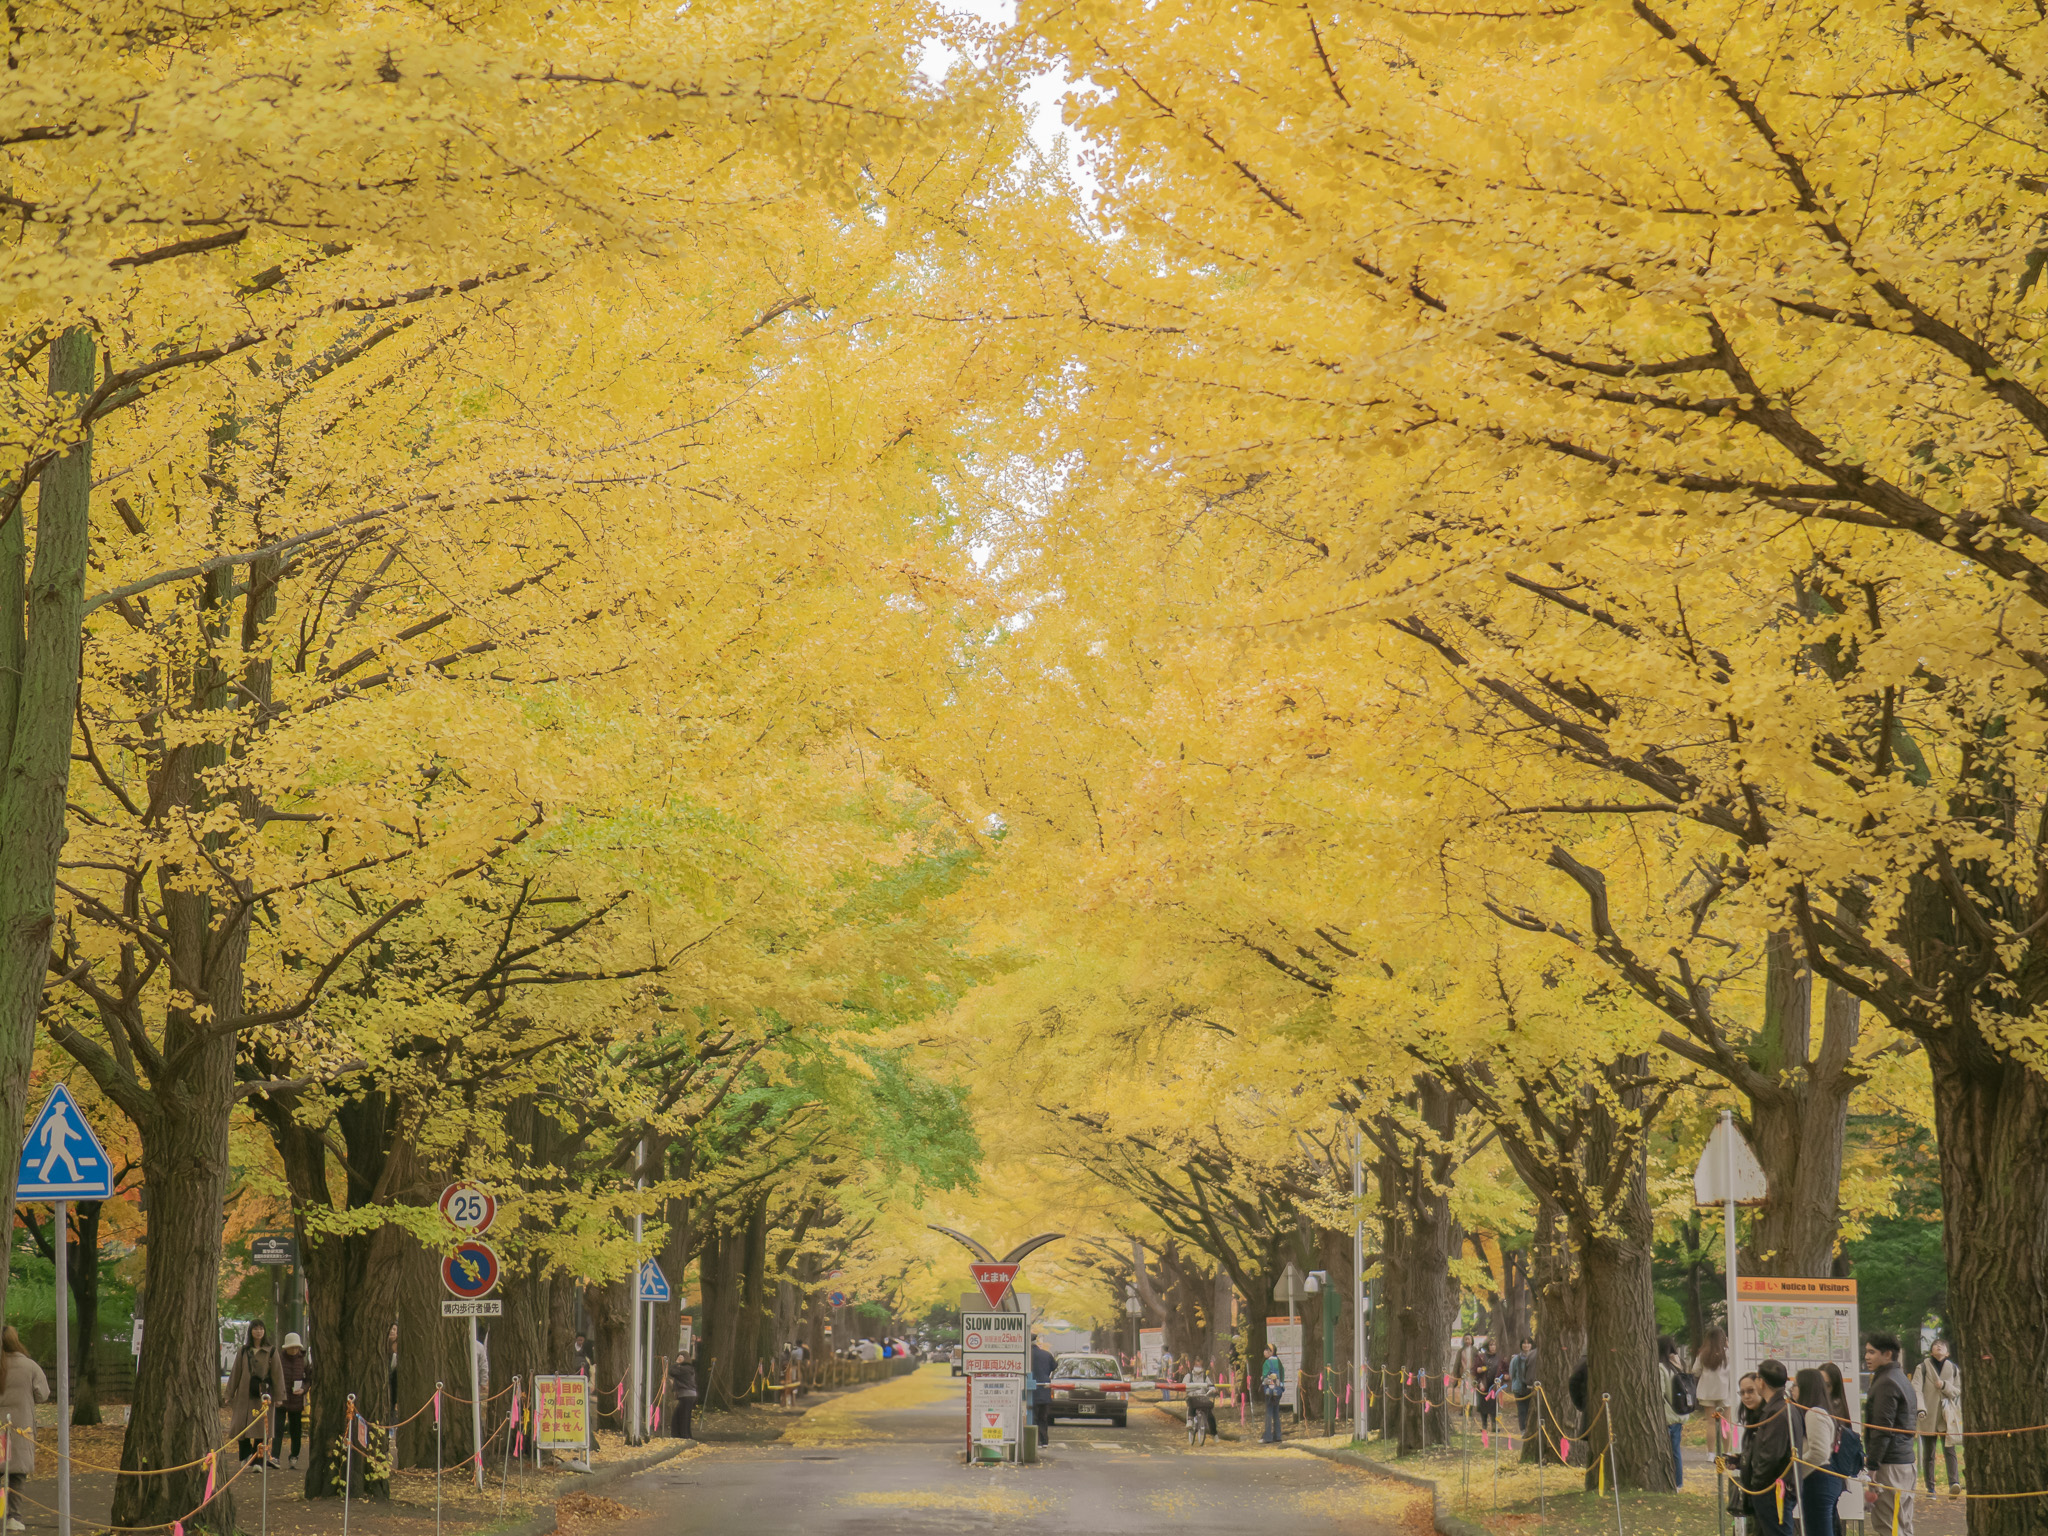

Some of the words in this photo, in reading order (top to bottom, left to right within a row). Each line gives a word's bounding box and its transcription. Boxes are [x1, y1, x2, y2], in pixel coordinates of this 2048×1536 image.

[455, 1196, 481, 1221] 25
[980, 1272, 1009, 1282] 止まれ
[1743, 1280, 1778, 1291] お願い
[1781, 1282, 1806, 1291] Notice
[1808, 1283, 1816, 1291] to
[1819, 1283, 1850, 1292] Visitors
[443, 1303, 500, 1314] 構内歩行者優先
[1834, 1309, 1849, 1317] MAP
[965, 1317, 992, 1331] SLOW
[994, 1317, 1023, 1331] DOWN
[969, 1337, 979, 1345] 25
[966, 1359, 1022, 1371] 許可車両以外は
[542, 1422, 583, 1433] きません
